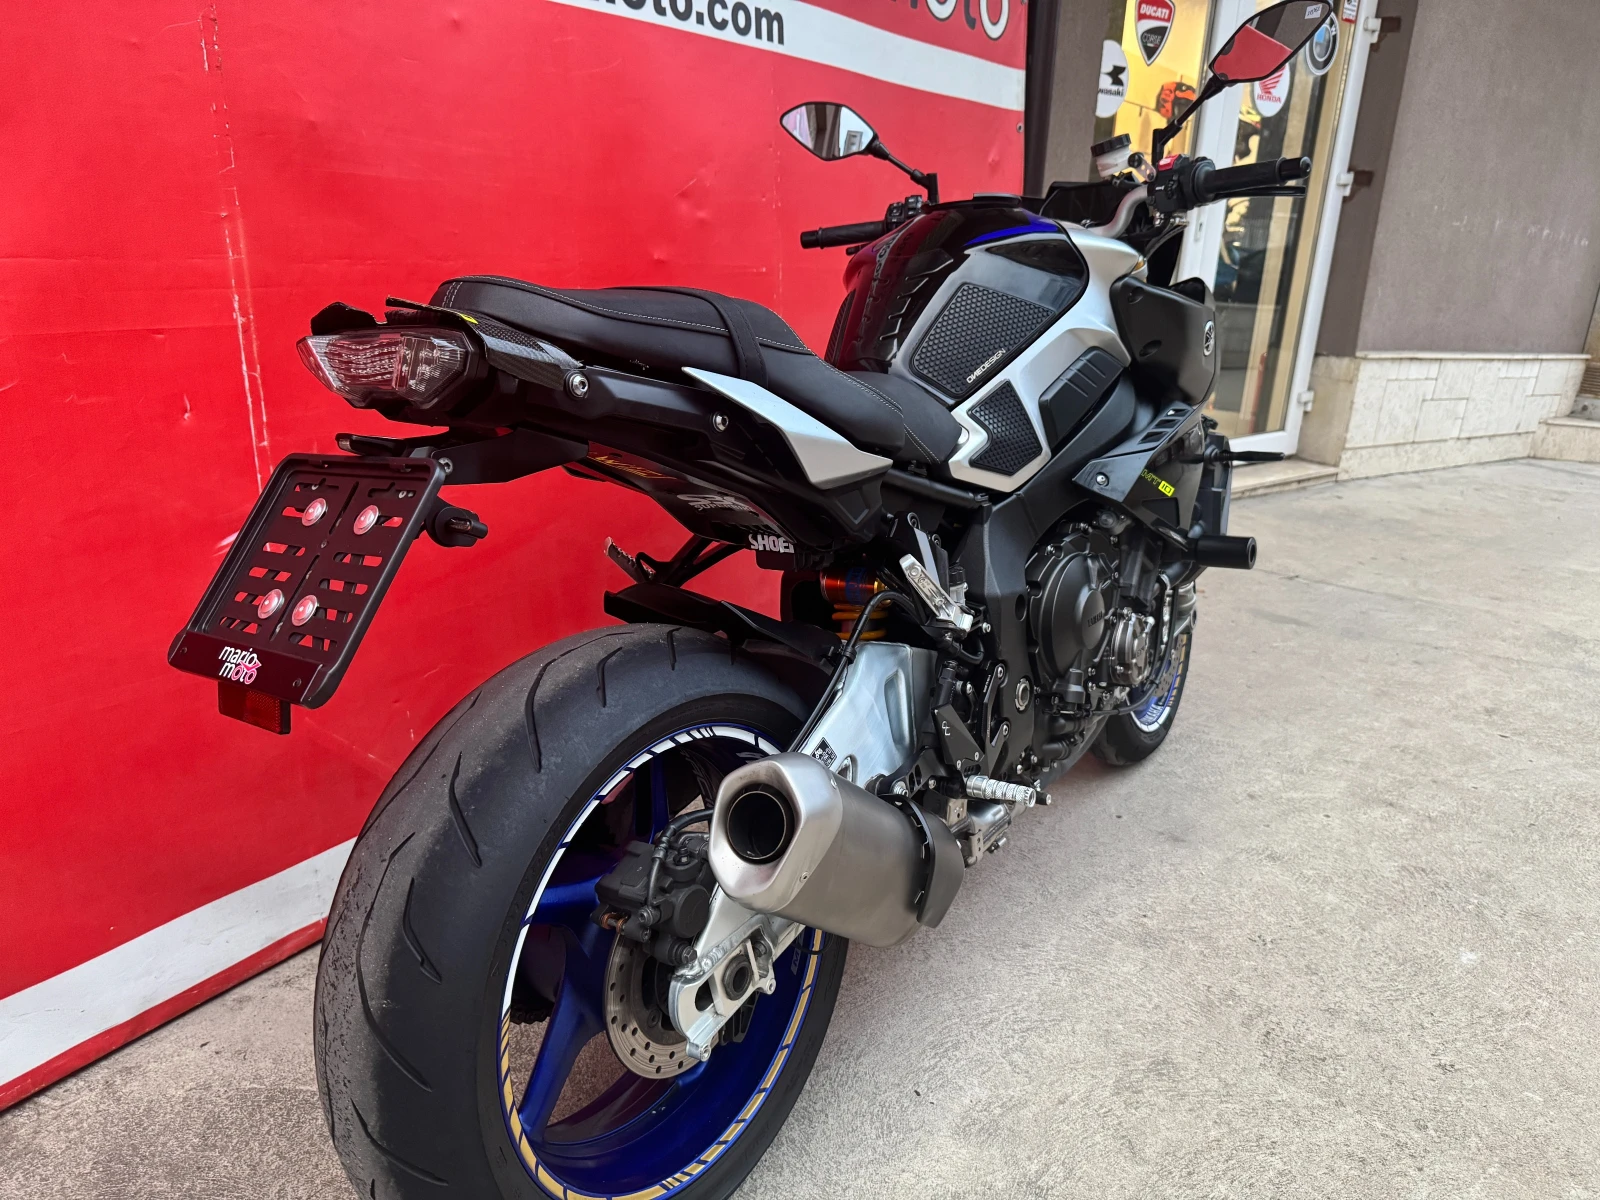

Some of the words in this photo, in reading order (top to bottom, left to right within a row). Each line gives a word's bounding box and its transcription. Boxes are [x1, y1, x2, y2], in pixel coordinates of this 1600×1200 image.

[1140, 3, 1169, 19] DUCATI
[596, 0, 785, 46] o.com
[1142, 33, 1162, 45] CORSE
[1256, 93, 1282, 104] HONDA
[966, 347, 1006, 384] ONEDESIGN
[218, 646, 258, 667] mario
[218, 662, 258, 685] moto
